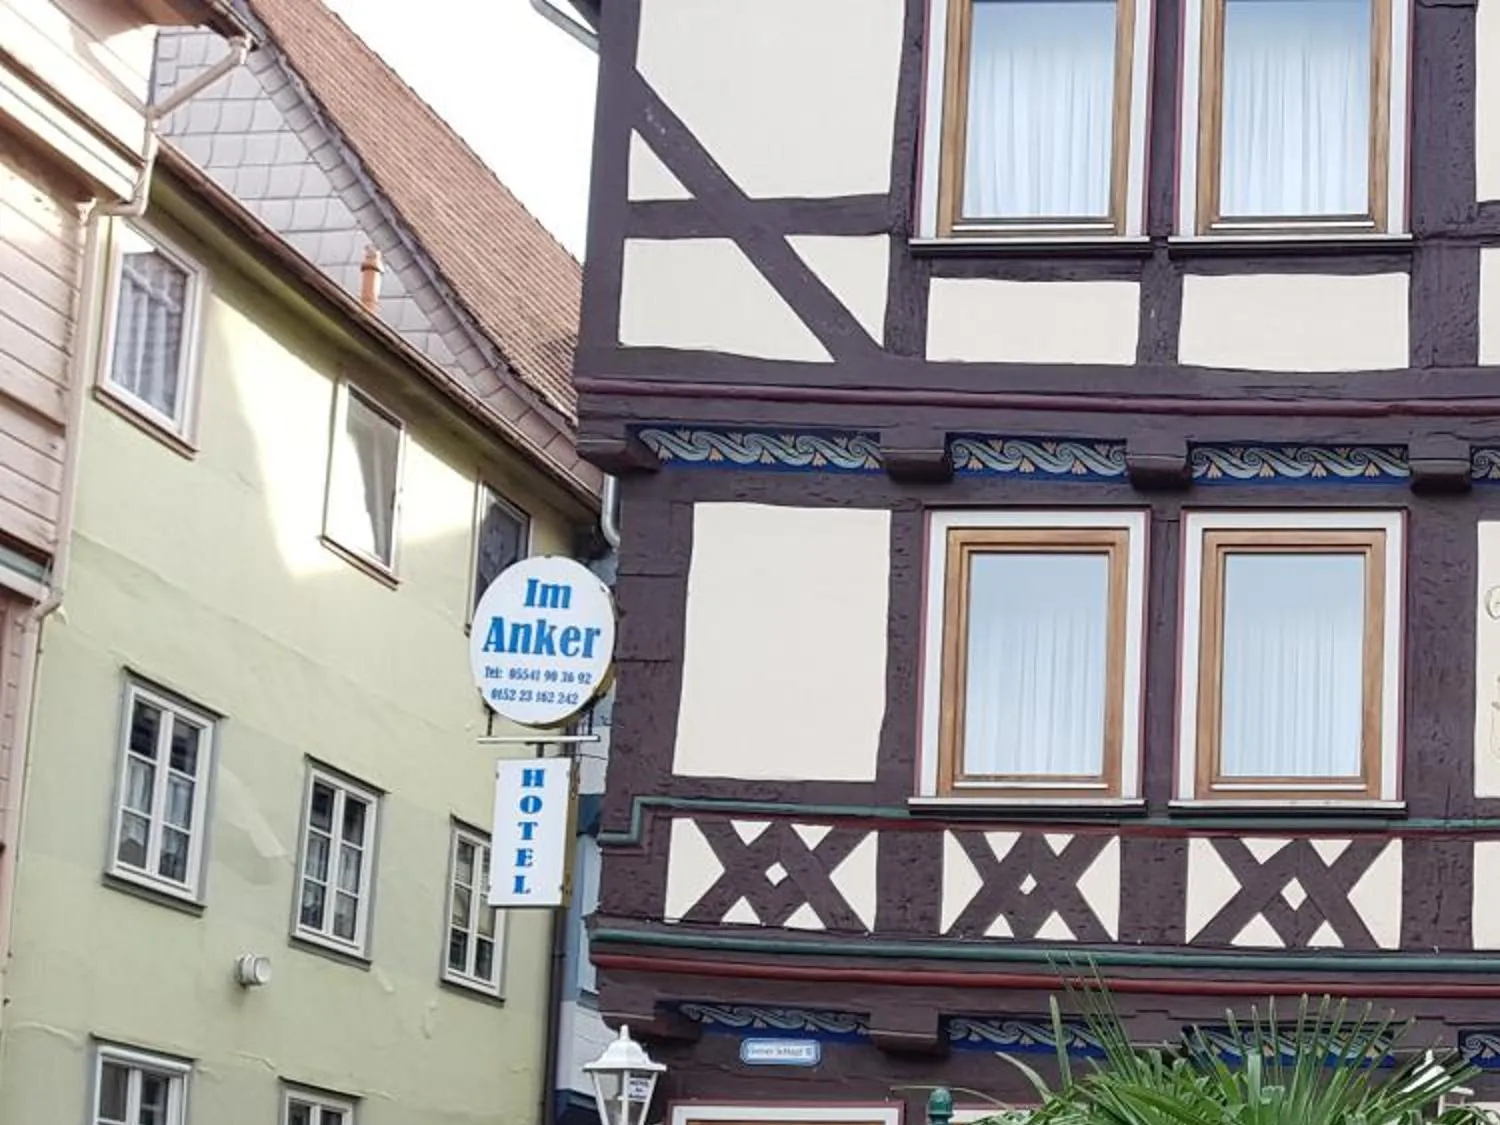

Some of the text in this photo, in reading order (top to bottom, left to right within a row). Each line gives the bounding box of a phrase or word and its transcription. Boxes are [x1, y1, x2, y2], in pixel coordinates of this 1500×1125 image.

[522, 577, 572, 609] Im
[481, 615, 602, 659] Anker
[511, 767, 546, 895] HOTEL
